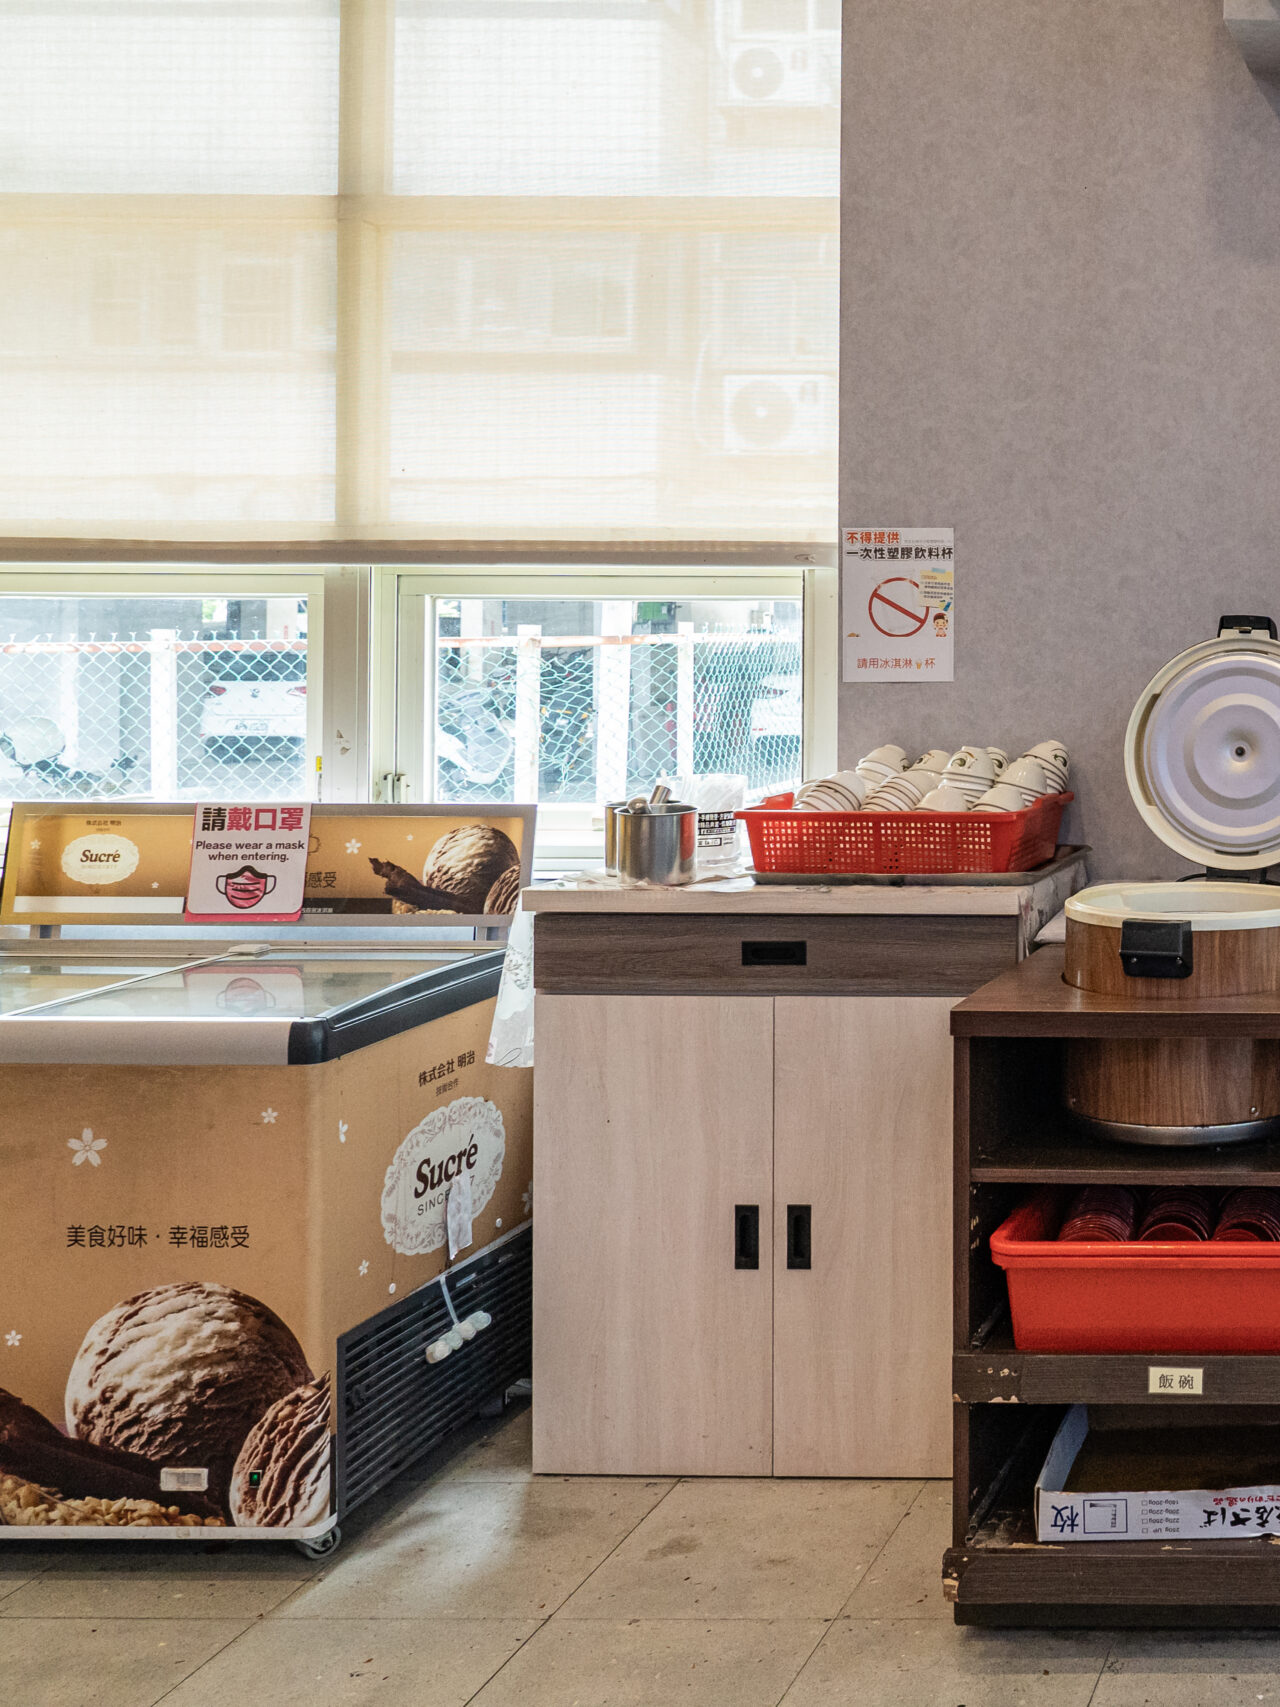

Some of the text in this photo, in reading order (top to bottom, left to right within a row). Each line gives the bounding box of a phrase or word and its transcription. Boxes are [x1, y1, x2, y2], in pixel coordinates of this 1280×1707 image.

[846, 531, 900, 545] 不得提供
[846, 546, 954, 560] 一次性塑膠飲料杯
[857, 657, 936, 670] 請用冰淇淋 杯
[201, 807, 304, 832] 請戴口罩
[196, 841, 232, 850] Please
[275, 840, 305, 850] mask
[80, 849, 121, 863] Sucré
[208, 852, 289, 862] when entering.
[418, 1050, 476, 1088] 株式会社 明治
[414, 1133, 478, 1199] Sucré
[1158, 1374, 1195, 1390] 飯碗
[1050, 1504, 1079, 1534] 枚
